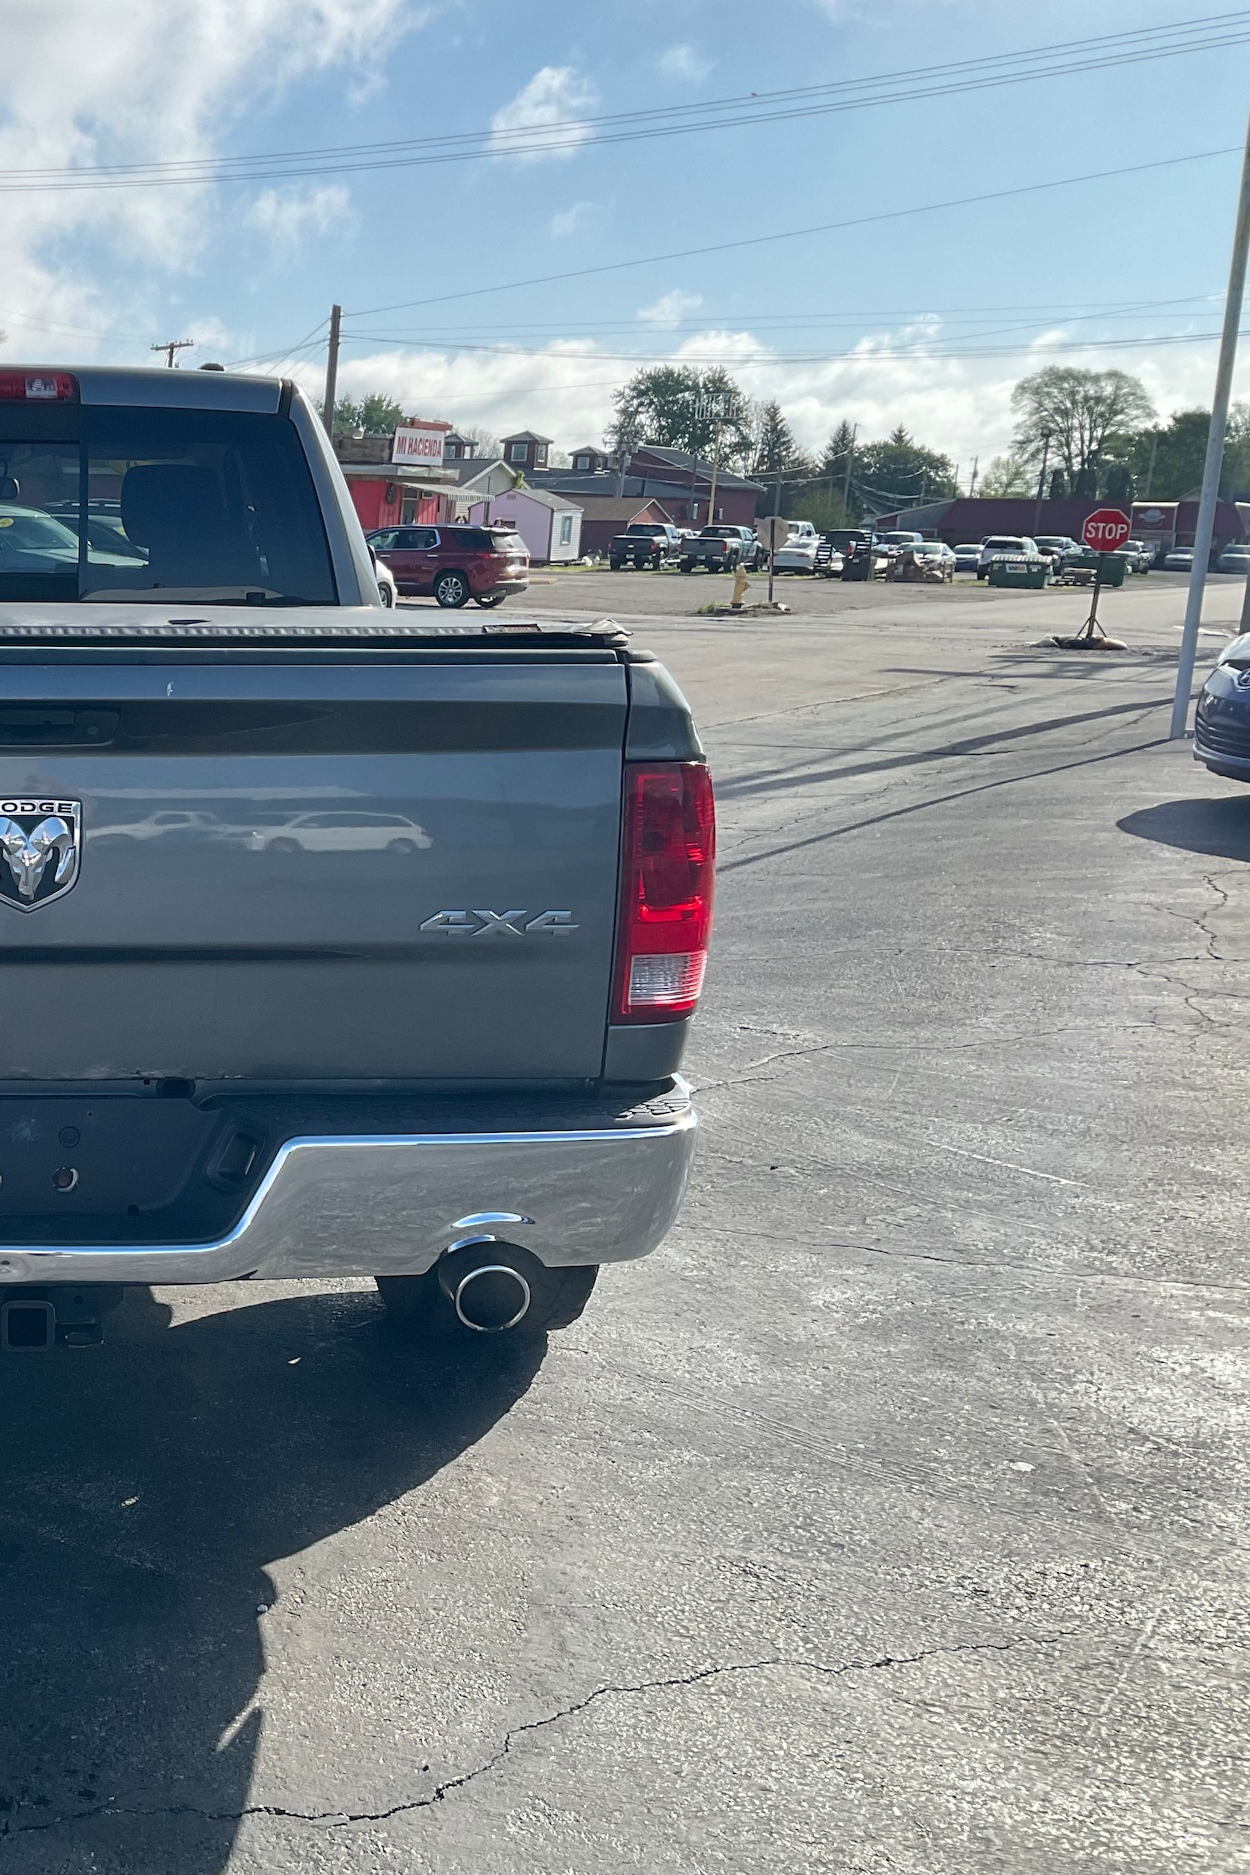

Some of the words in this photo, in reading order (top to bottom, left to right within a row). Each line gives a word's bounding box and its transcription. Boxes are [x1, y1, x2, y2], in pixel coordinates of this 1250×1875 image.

[396, 436, 407, 455] MI
[407, 436, 442, 458] HACIENDA
[1086, 522, 1128, 540] STOP
